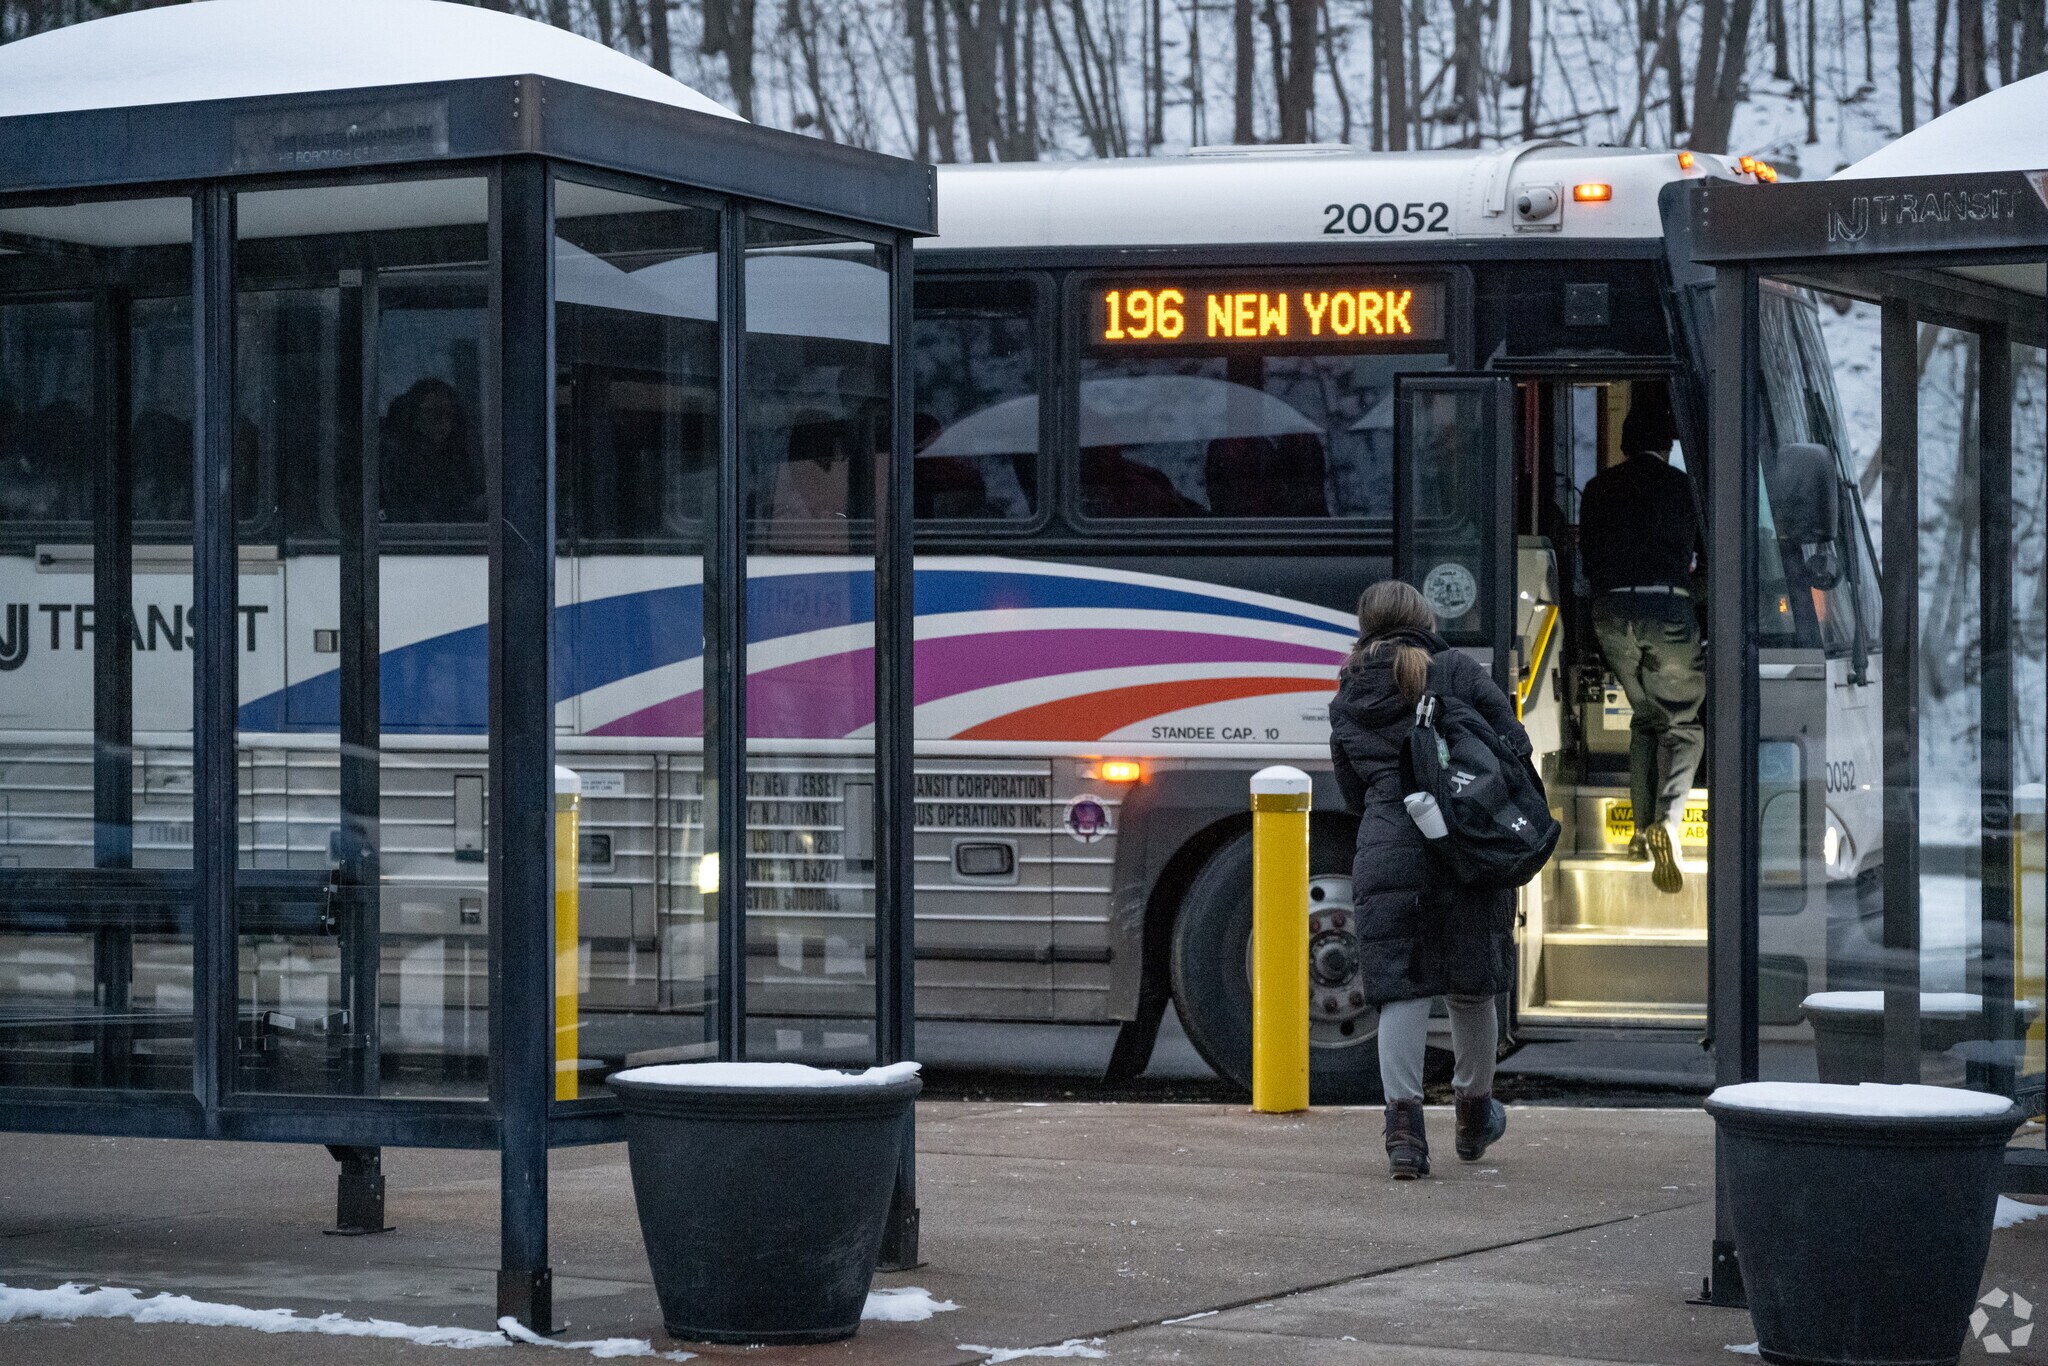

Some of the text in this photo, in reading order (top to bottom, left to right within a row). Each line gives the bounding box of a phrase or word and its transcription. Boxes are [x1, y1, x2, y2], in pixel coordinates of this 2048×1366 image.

[417, 124, 433, 138] BY
[1323, 202, 1449, 235] 20052
[1828, 189, 2022, 242] NJ TRANSIT
[1105, 290, 1412, 339] 196 NEW YORK
[1152, 727, 1279, 740] STANDEE CAP. 10
[764, 774, 789, 796] NEW
[795, 773, 838, 797] JERSEY
[914, 775, 951, 797] ANSIT
[957, 775, 1046, 798] CORPORATION
[1825, 761, 1857, 793] 0052
[762, 803, 784, 825] N.J.
[790, 803, 839, 826] TRANSIT
[938, 805, 1016, 826] OPERATIONS
[1021, 806, 1047, 827] INC.
[753, 831, 790, 853] USDOT
[803, 860, 839, 882] 63247
